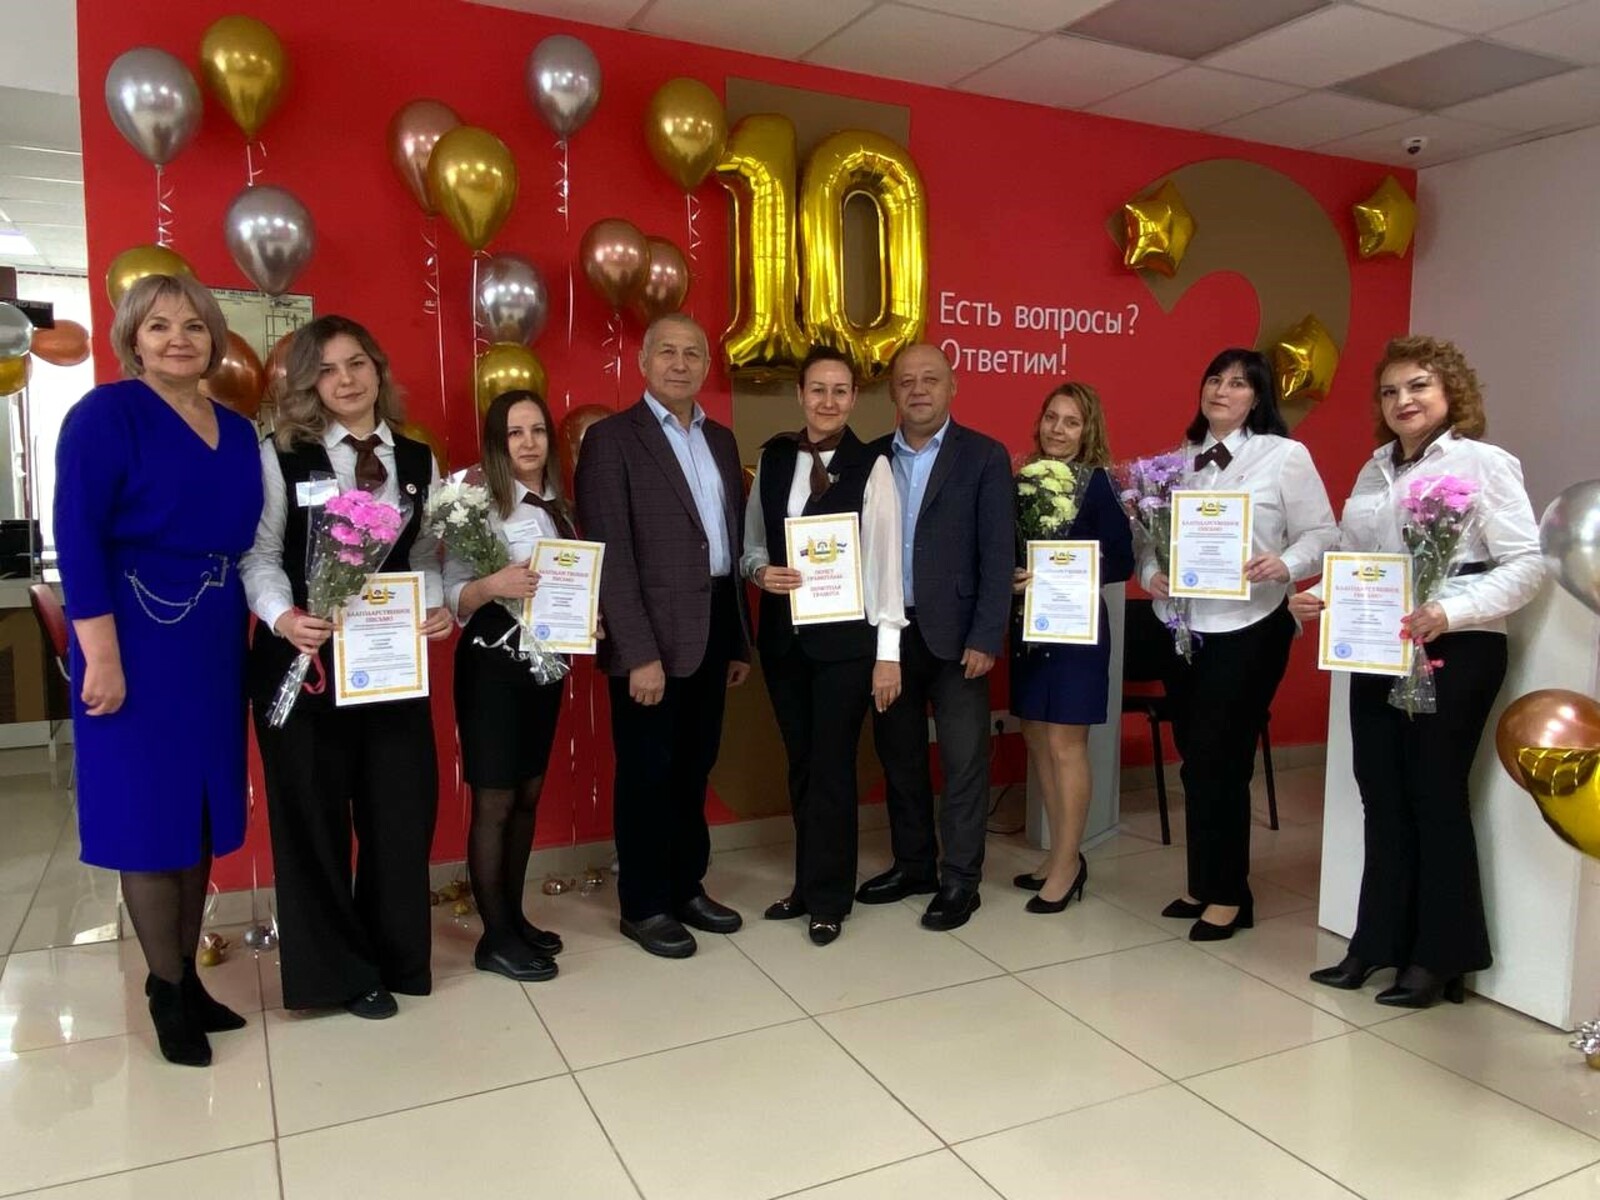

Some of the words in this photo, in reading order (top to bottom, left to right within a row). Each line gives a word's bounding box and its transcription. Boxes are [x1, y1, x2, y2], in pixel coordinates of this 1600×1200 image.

[715, 113, 928, 381] 10
[940, 291, 1002, 327] Есть
[1015, 303, 1140, 340] вопросы?
[940, 338, 1068, 376] Ответим!
